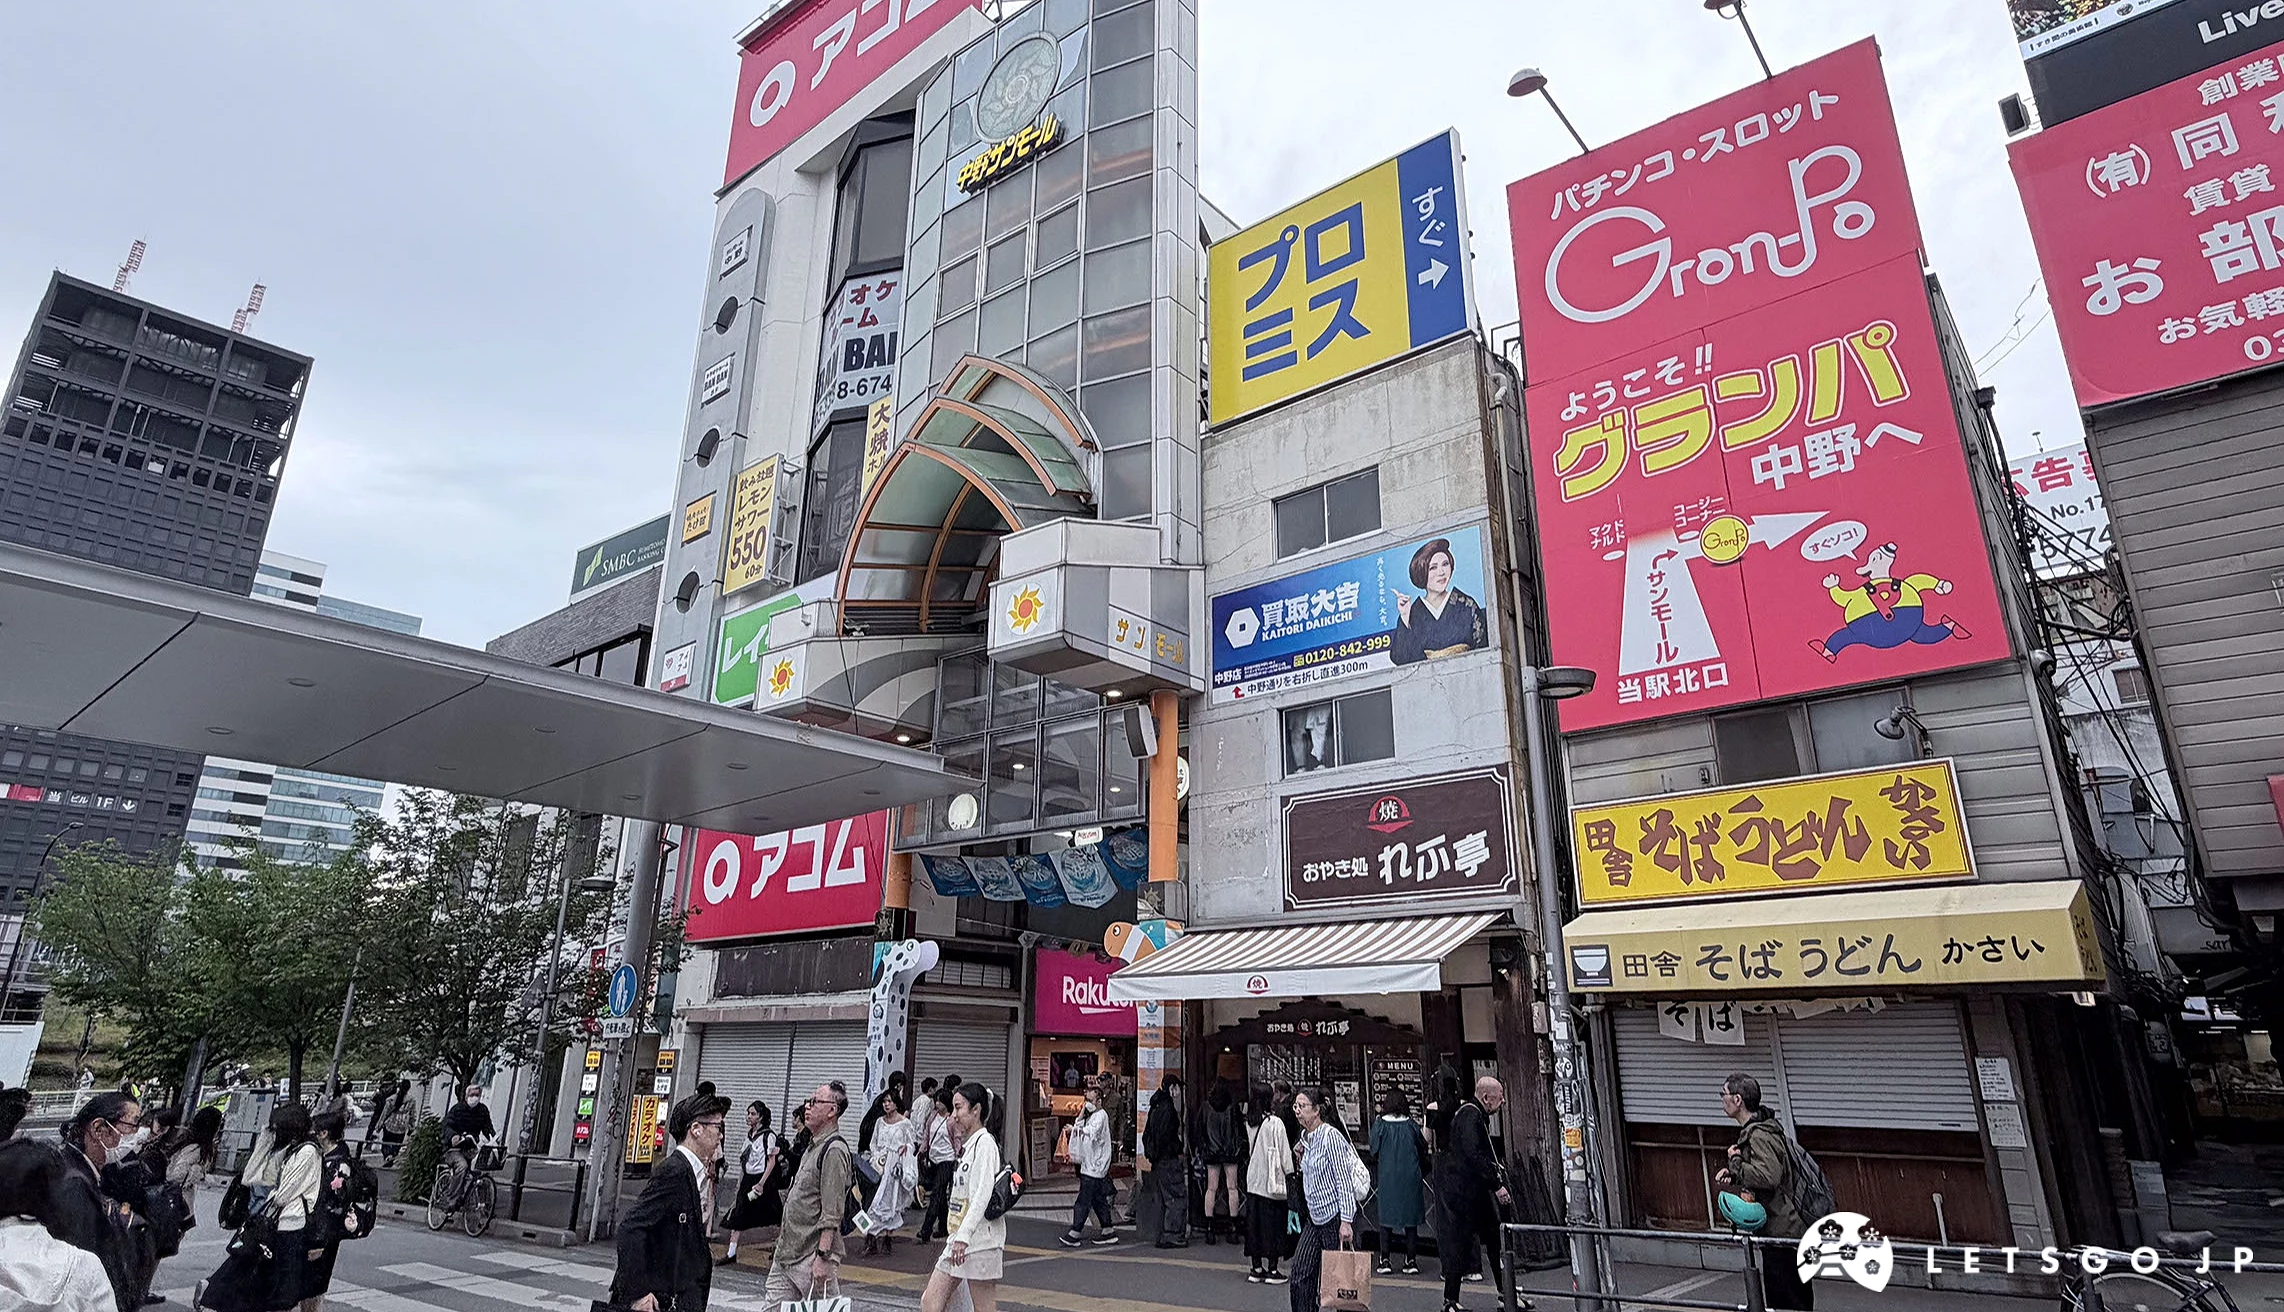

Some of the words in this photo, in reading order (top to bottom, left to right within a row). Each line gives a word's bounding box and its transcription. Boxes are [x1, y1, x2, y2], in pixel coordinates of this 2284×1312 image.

[2197, 52, 2284, 106] 創業
[957, 112, 1059, 192] 中野サンモール
[1412, 186, 1447, 248] すぐ
[1554, 320, 1910, 502] グランパ
[1751, 422, 1924, 490] 中野へ
[738, 484, 772, 512] レモン
[739, 464, 775, 493] 飲み放題
[734, 507, 770, 532] サワー
[1589, 519, 1624, 537] マクド
[1590, 530, 1626, 550] ナルド
[601, 549, 637, 577] SMBC
[730, 525, 767, 571] 550
[745, 565, 763, 579] 60分
[1261, 581, 1361, 631] 買取大吉
[1261, 624, 1304, 642] KAITORI
[1306, 610, 1353, 632] DAIKICHI
[1647, 570, 1680, 665] サンモール
[721, 622, 769, 674] レイ
[1116, 618, 1184, 665] サンモール
[1214, 668, 1243, 685] 中野店
[1247, 661, 1369, 694] 中野通りを右折し直進300m
[1617, 663, 1730, 704] 当駅北口
[1378, 801, 1399, 821] 焼
[750, 819, 866, 900] アコム
[1303, 857, 1369, 884] おやき処
[1623, 949, 1682, 978] 田舎
[1696, 939, 1783, 981] そば
[1798, 933, 1922, 979] うどん
[1942, 934, 2045, 965] かさい
[1387, 1061, 1414, 1071] MENU
[642, 1098, 655, 1145] カラオケ
